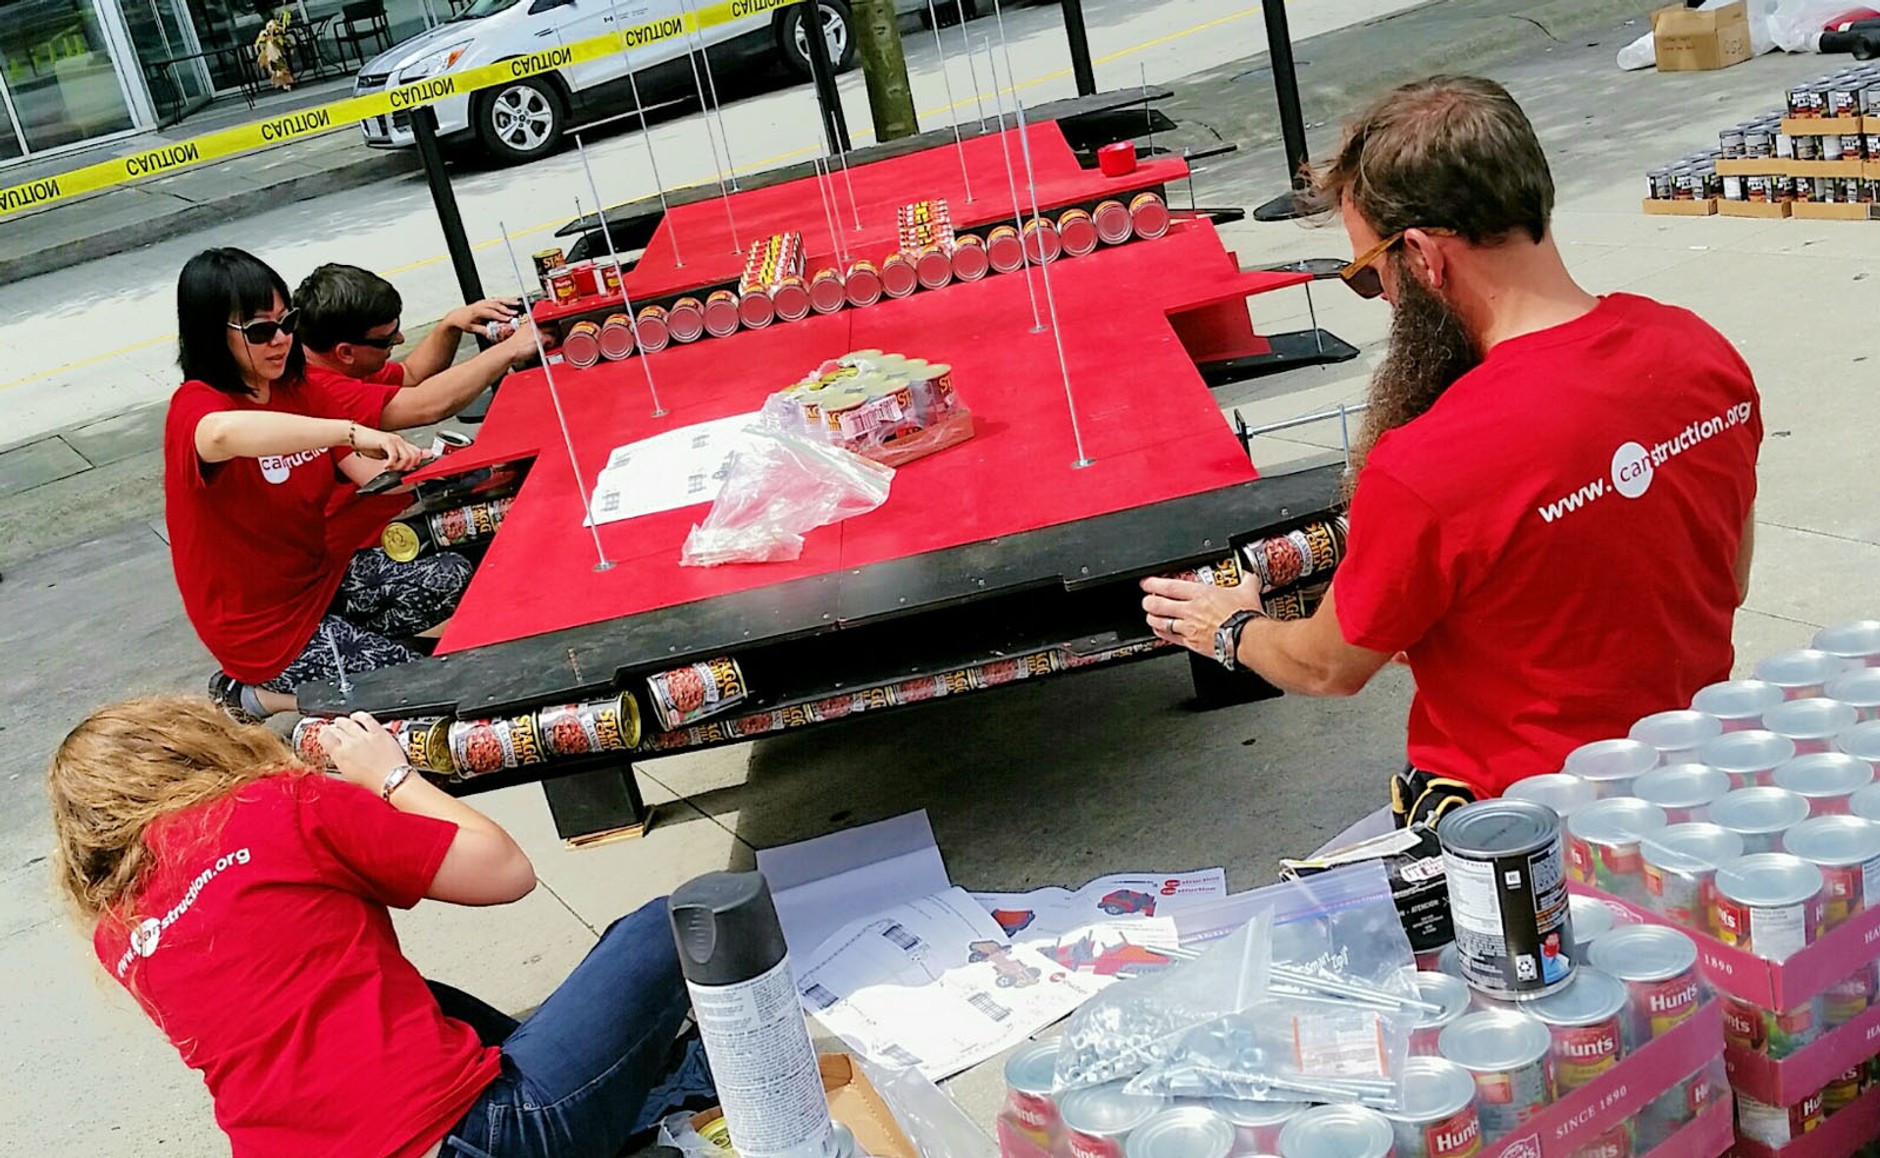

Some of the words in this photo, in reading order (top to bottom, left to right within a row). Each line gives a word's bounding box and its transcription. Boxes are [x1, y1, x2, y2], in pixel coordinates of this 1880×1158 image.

[1539, 401, 1752, 523] www.canstruction.org
[1217, 558, 1239, 587] STA
[1704, 954, 1734, 975] 1890
[1556, 1105, 1596, 1139] SINCE
[1600, 1085, 1628, 1110] 1890
